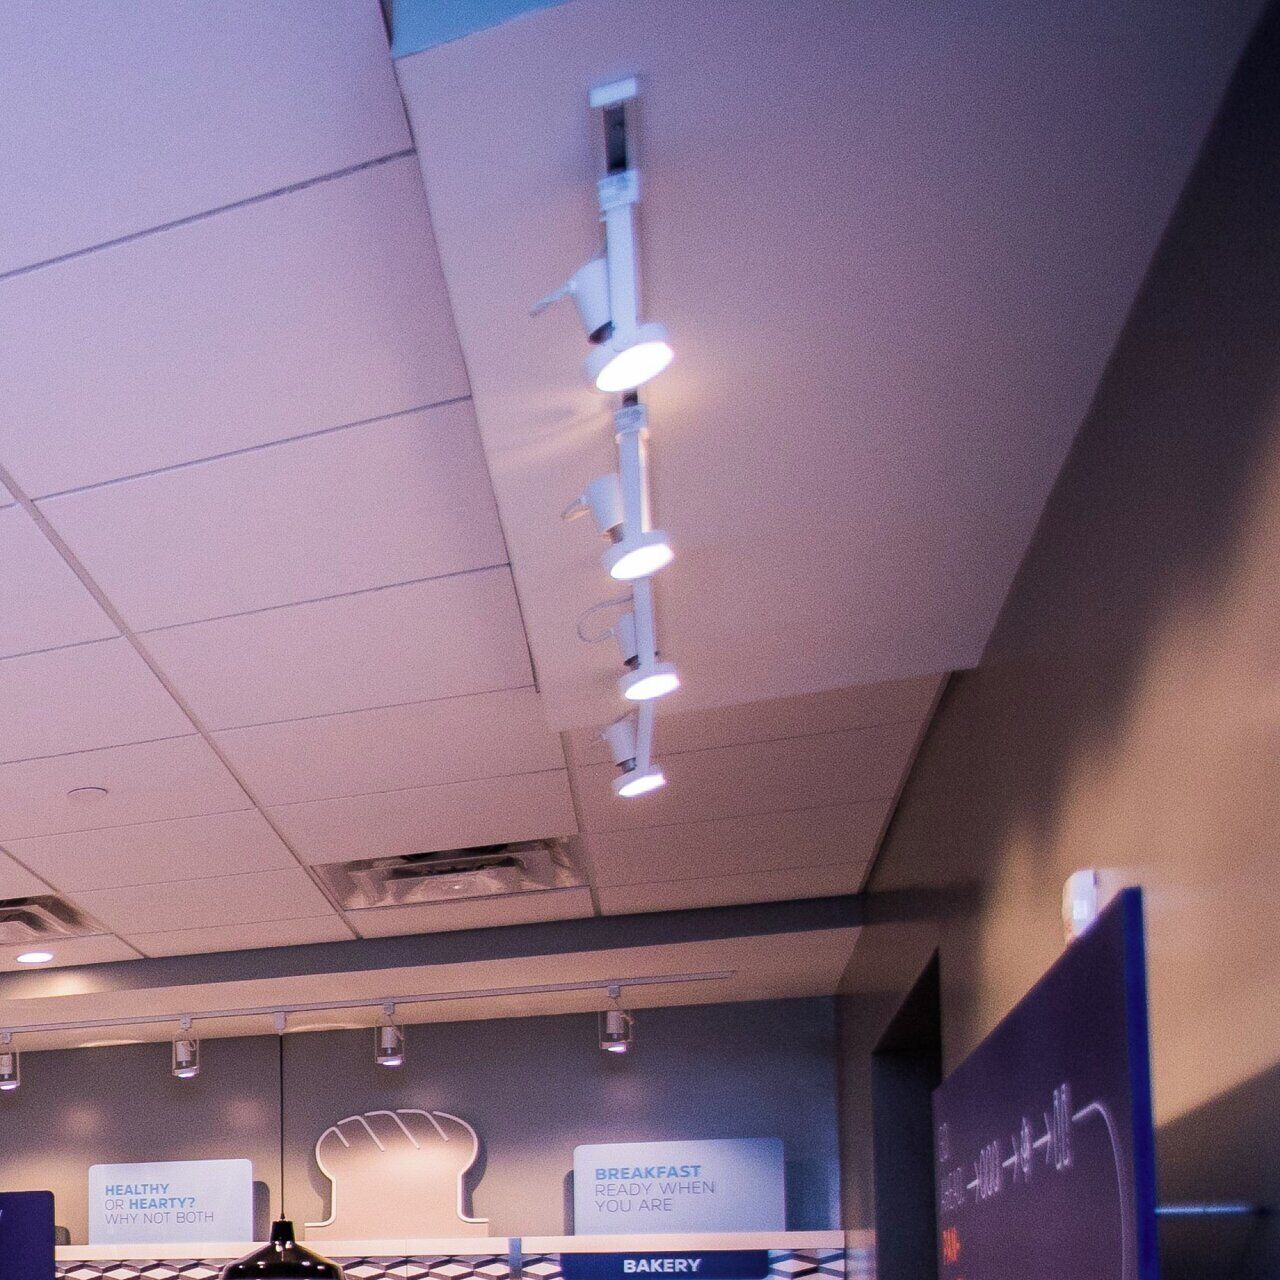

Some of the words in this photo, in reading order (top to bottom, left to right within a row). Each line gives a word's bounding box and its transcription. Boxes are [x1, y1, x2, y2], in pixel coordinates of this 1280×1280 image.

[595, 1165, 702, 1180] BREAKFAST
[105, 1183, 170, 1196] HEALTHY
[595, 1182, 652, 1196] READY
[659, 1181, 715, 1195] WHEN
[105, 1199, 124, 1210] OR
[129, 1197, 195, 1210] HEARTY?
[595, 1199, 632, 1212] YOU
[639, 1198, 672, 1212] ARE
[105, 1213, 138, 1224] WHY
[143, 1212, 171, 1224] NOT
[176, 1211, 214, 1224] BOTH
[623, 1259, 702, 1273] BAKERY
